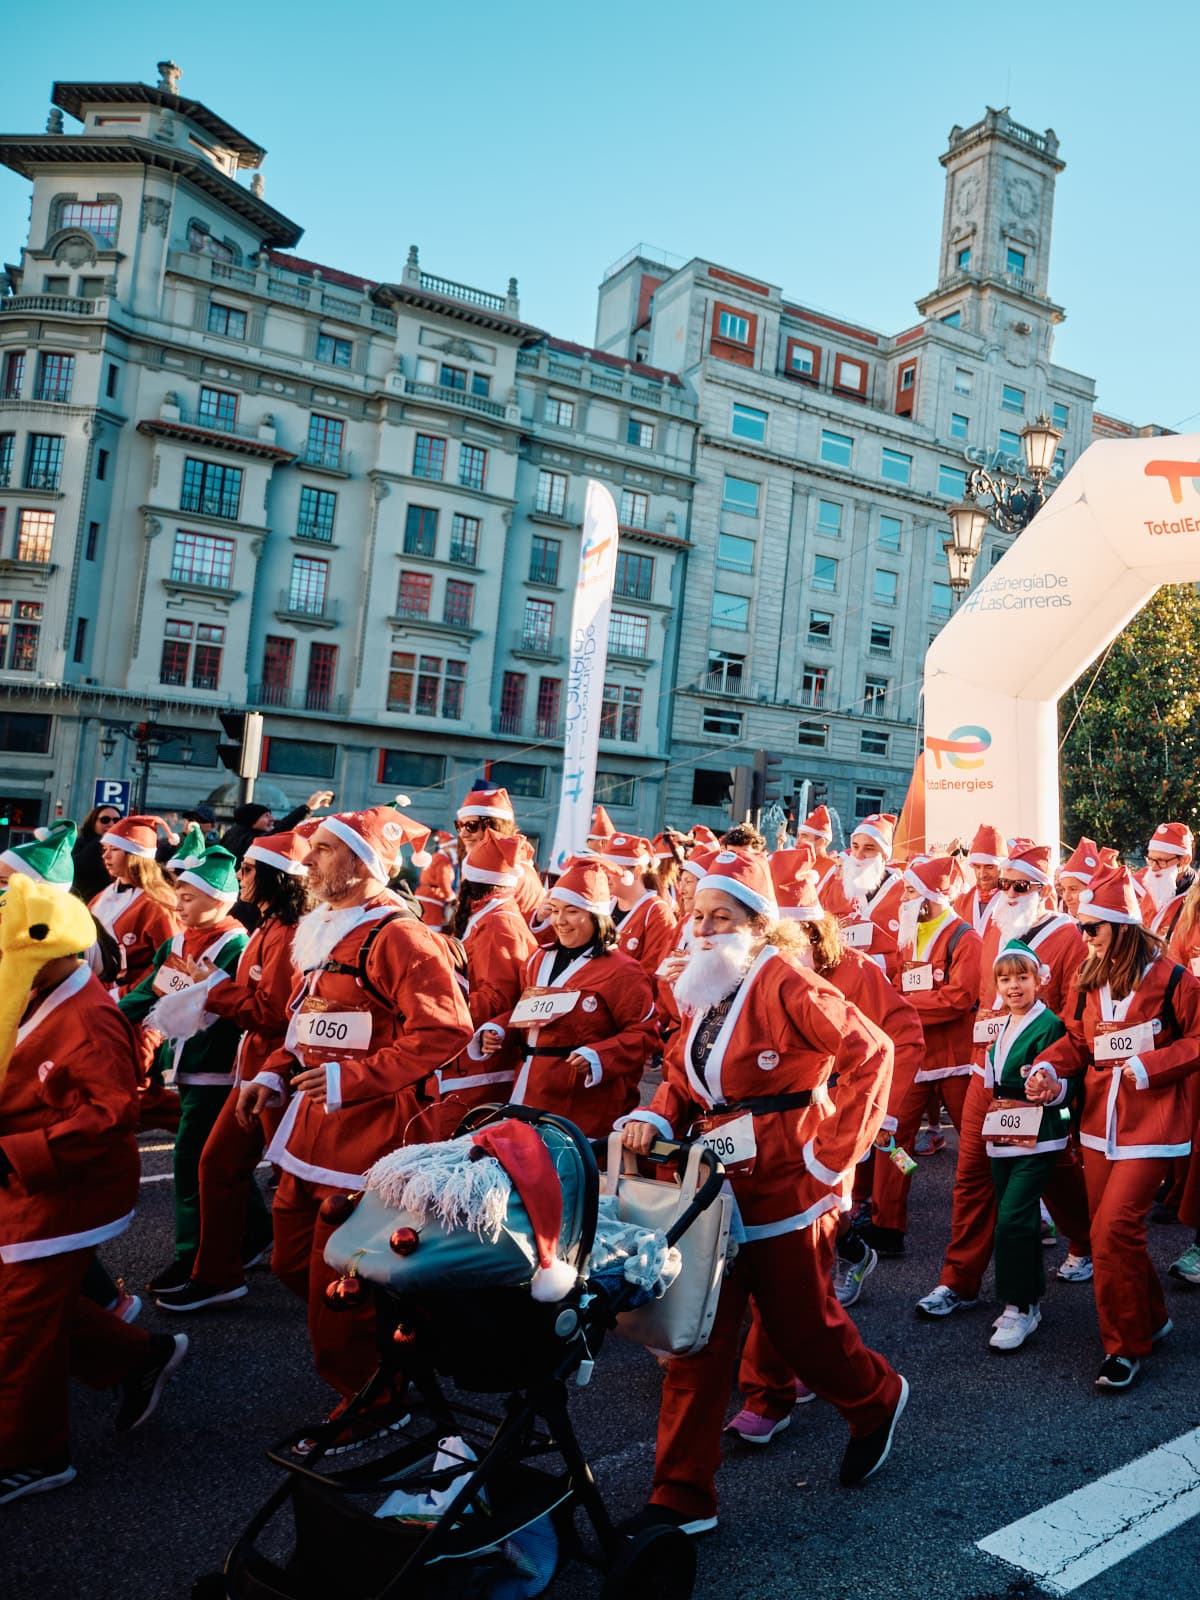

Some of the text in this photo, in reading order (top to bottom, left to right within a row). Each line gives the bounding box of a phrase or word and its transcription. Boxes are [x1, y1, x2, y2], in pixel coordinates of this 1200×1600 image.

[980, 593, 1072, 611] LasCarreras
[103, 781, 122, 802] P
[531, 1001, 553, 1013] 310
[309, 1018, 348, 1040] 1050
[1110, 1037, 1133, 1050] 602
[1001, 1114, 1021, 1128] 603
